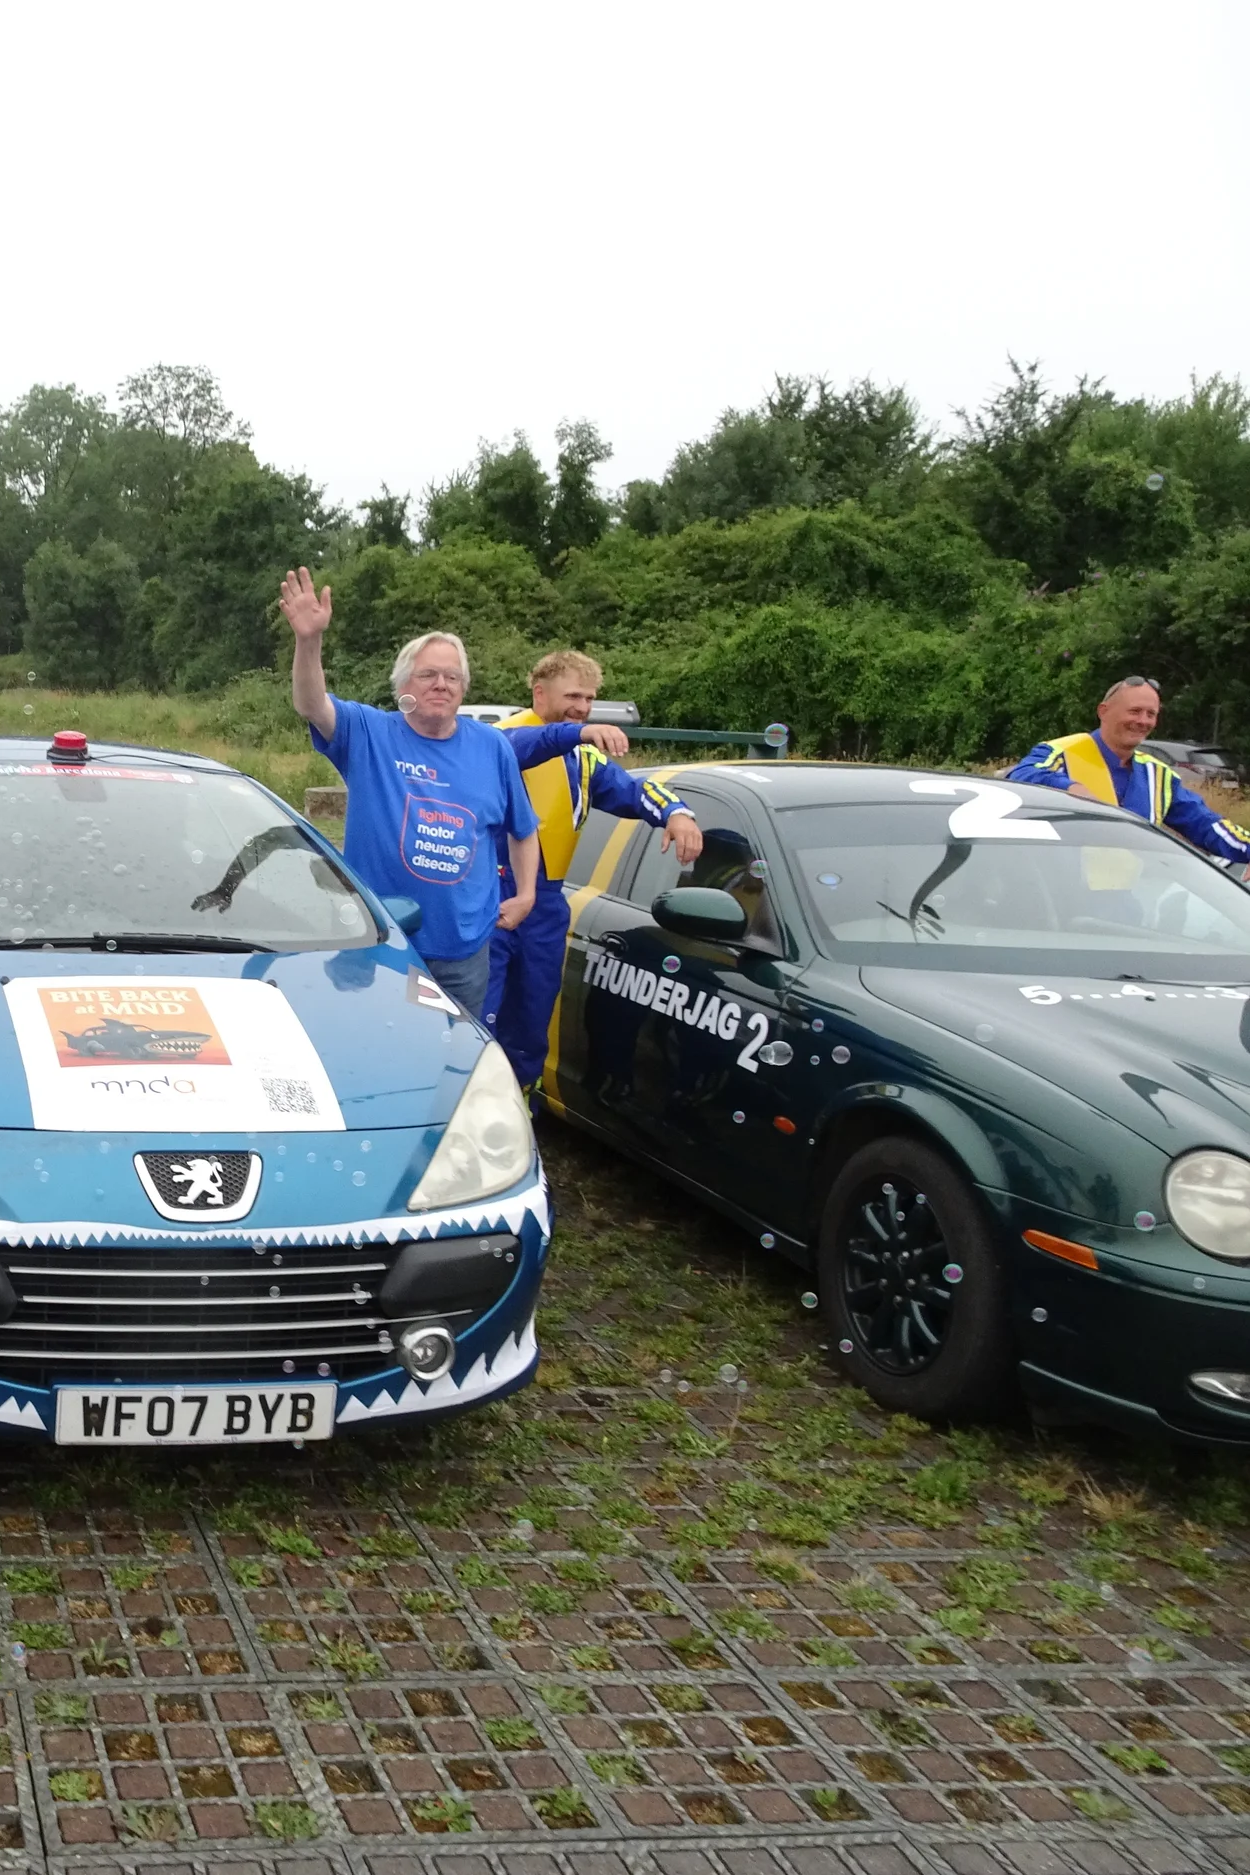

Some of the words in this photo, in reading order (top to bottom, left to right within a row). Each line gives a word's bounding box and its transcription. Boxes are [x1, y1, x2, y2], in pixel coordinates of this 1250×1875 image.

[418, 807, 464, 828] fighting
[908, 779, 1061, 840] 2
[417, 823, 456, 840] motor
[415, 839, 467, 858] neurone
[411, 854, 460, 873] disease
[50, 989, 111, 1003] BITE
[119, 989, 192, 1003] BACK
[74, 1004, 96, 1015] at
[102, 1002, 187, 1016] MND
[582, 949, 742, 1041] THUNDERJAG
[736, 1012, 769, 1074] 2
[91, 1075, 197, 1094] mnda
[82, 1395, 209, 1437] WF07
[223, 1392, 316, 1435] BYB
